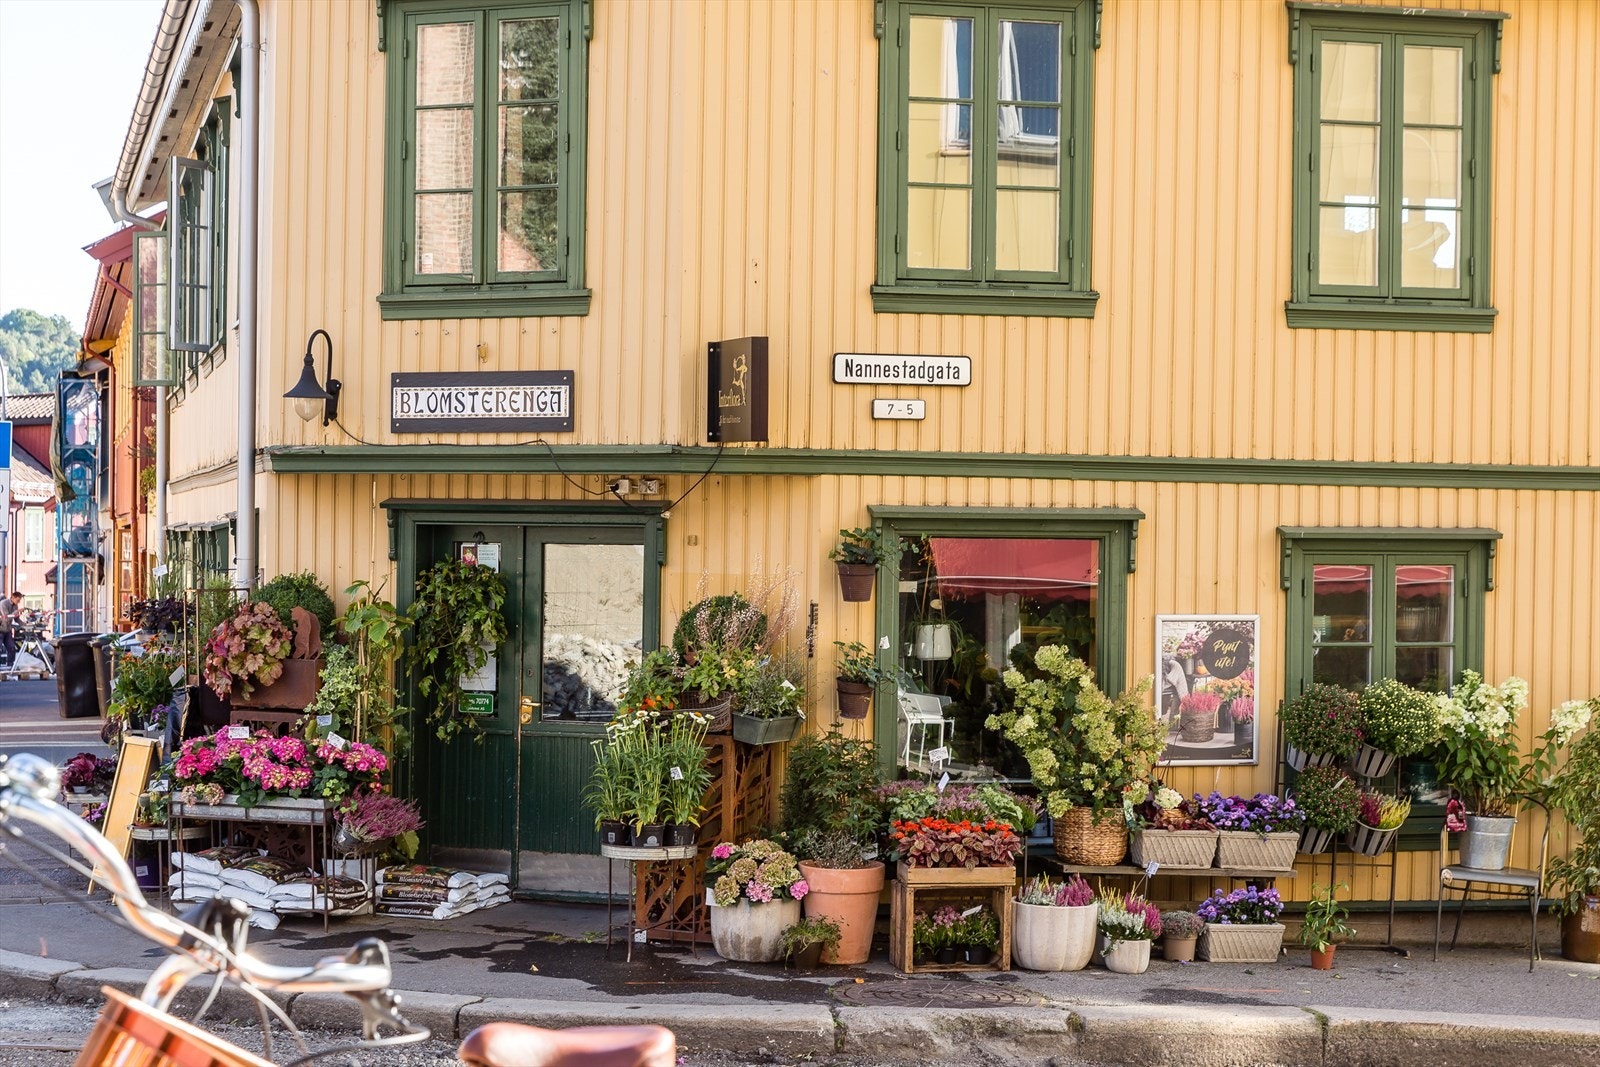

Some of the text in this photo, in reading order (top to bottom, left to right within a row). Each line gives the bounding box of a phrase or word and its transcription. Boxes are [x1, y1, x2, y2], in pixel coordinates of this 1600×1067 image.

[845, 358, 960, 383] Nannestadgata
[400, 390, 562, 414] BLOMSTERENGA
[1213, 639, 1241, 654] Pynt
[1214, 656, 1236, 668] ute!
